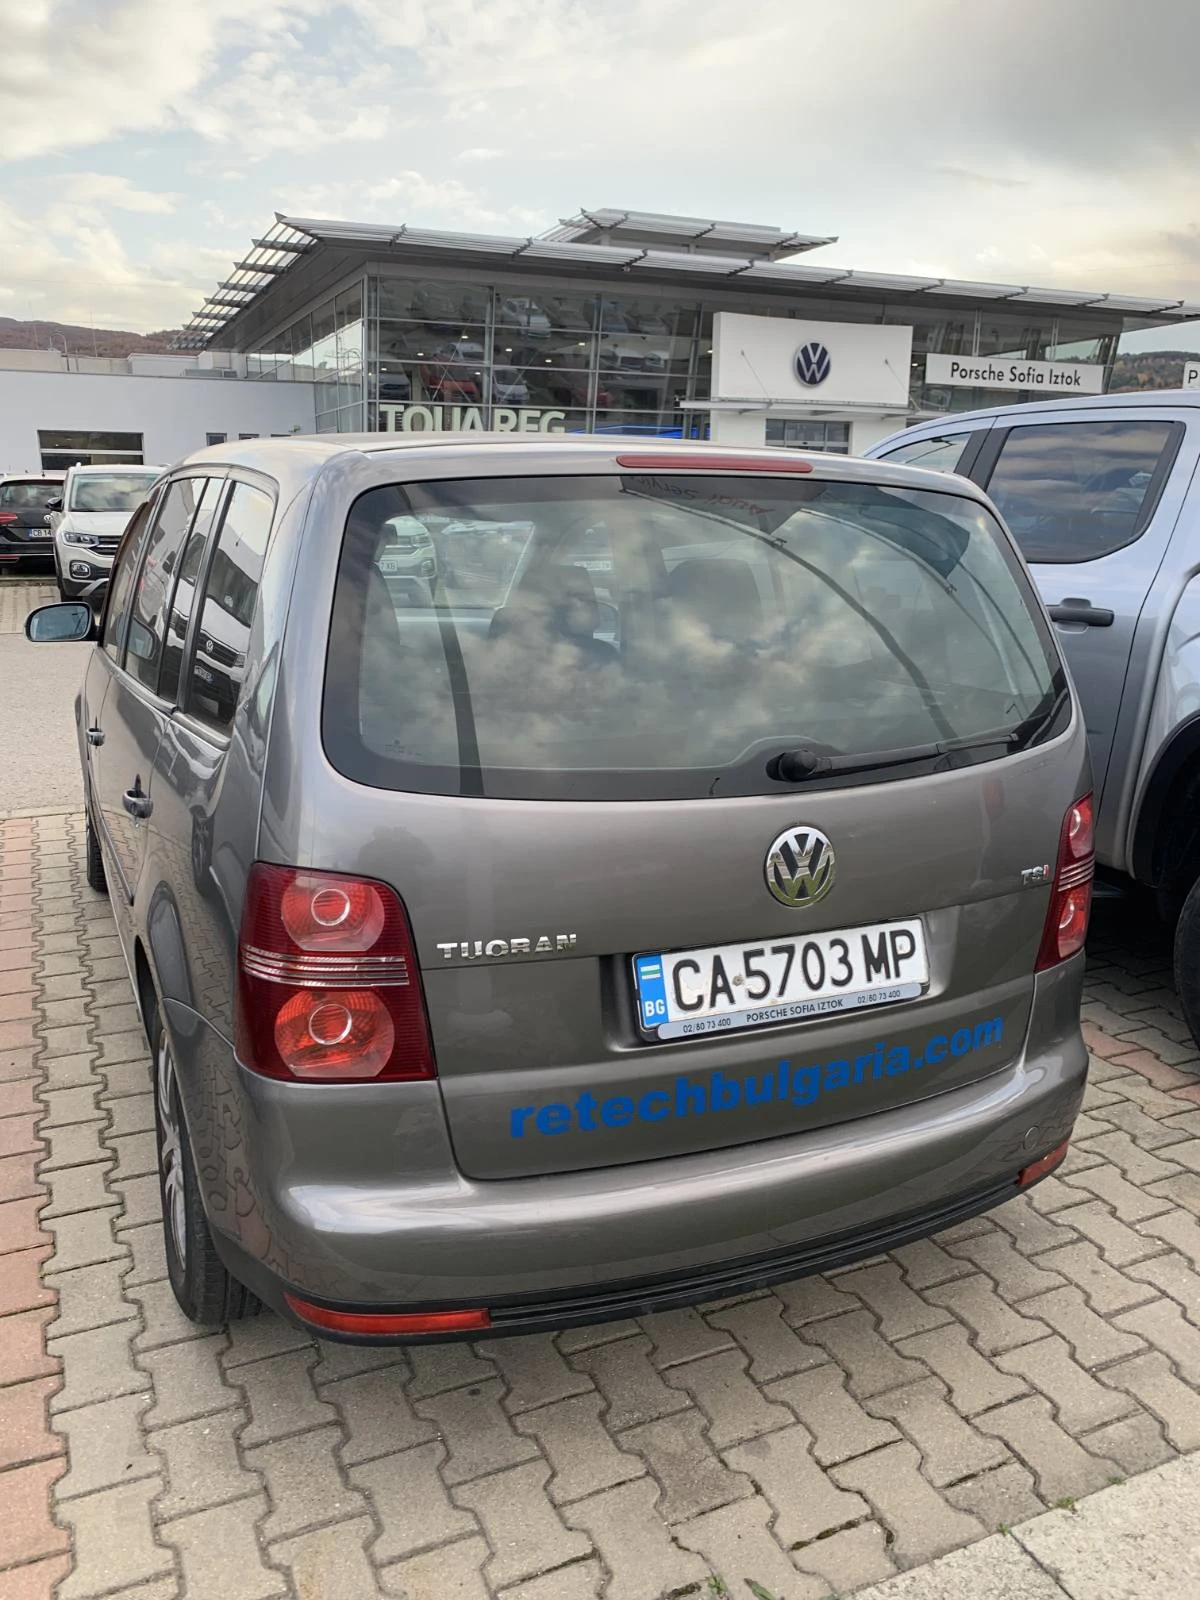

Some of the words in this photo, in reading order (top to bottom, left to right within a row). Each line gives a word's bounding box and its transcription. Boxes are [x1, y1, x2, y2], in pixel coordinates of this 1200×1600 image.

[950, 362, 1005, 382] Porsche
[1009, 366, 1044, 384] Sofia
[1049, 368, 1081, 387] Iztok
[379, 403, 566, 433] TOUAREG
[644, 998, 666, 1017] BG
[671, 954, 737, 1012] CA
[743, 938, 854, 1001] 5703
[861, 929, 917, 982] MP
[745, 1008, 788, 1023] PORSCHE
[789, 1003, 816, 1016] SOFIA
[817, 998, 844, 1011] IZTOK
[509, 1017, 1005, 1139] retechbulgaria.com
